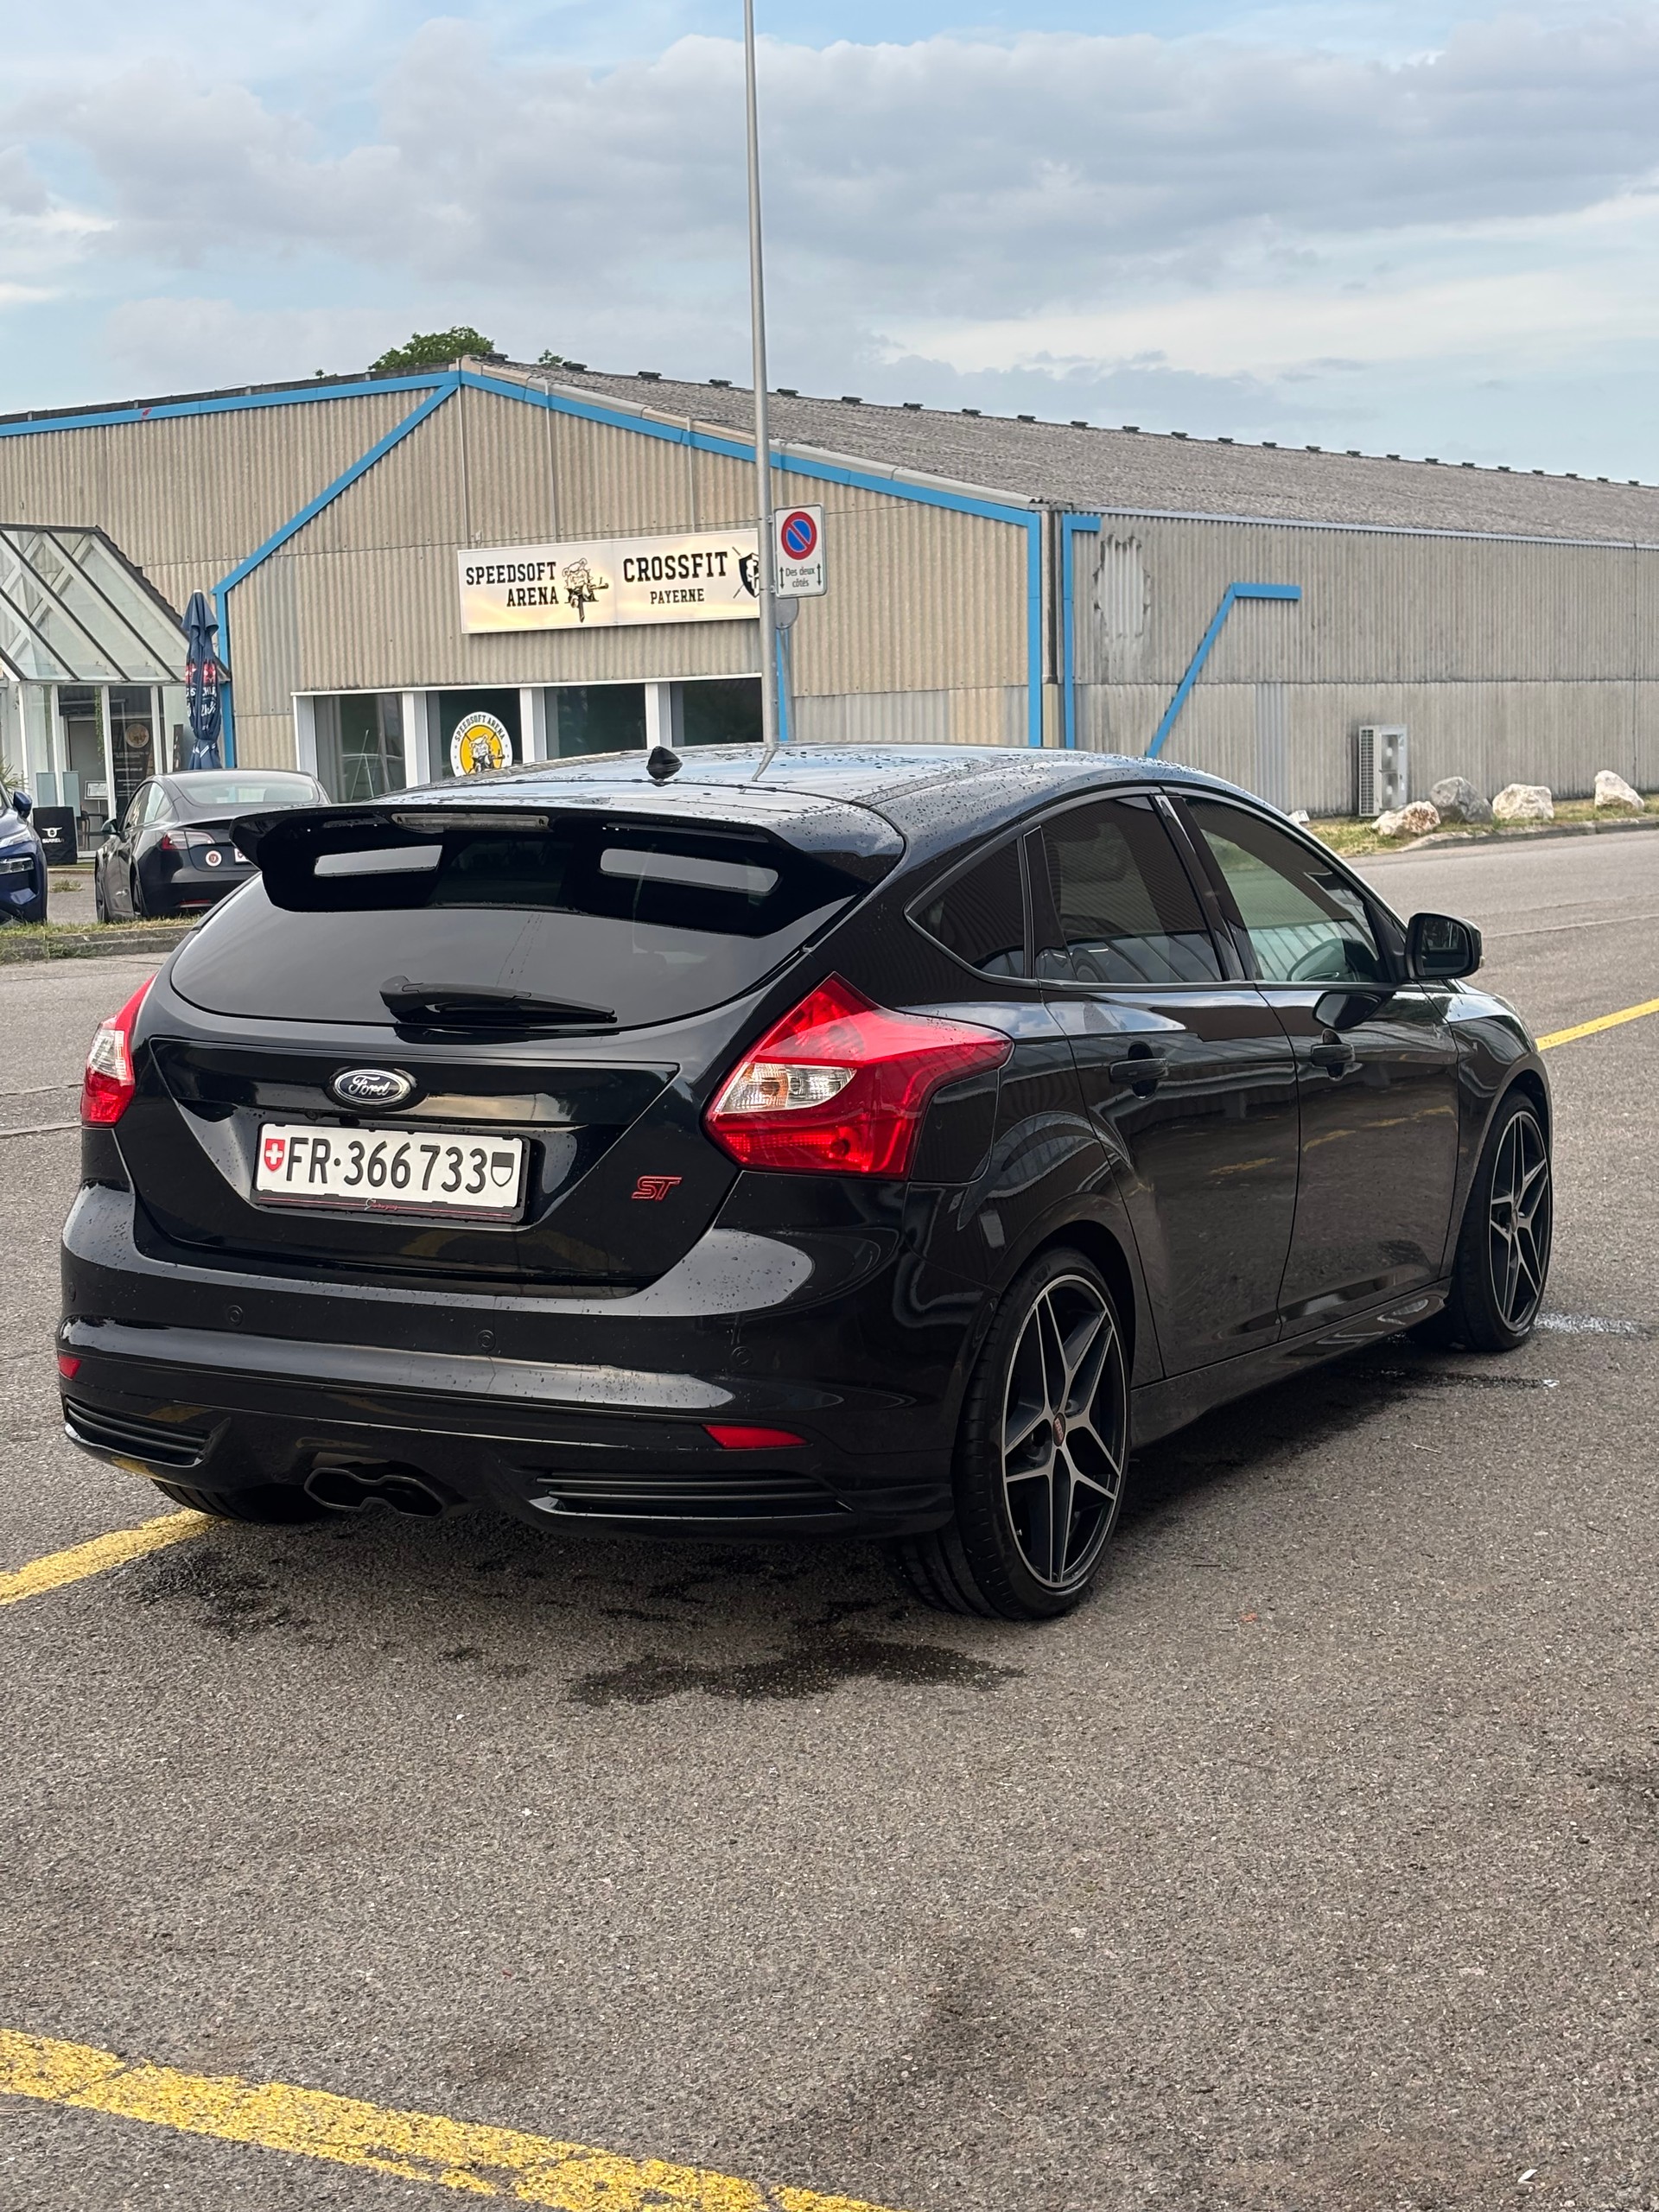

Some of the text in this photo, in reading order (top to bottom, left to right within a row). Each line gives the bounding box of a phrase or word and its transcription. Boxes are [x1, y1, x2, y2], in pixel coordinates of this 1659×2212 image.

[466, 562, 556, 585] SPEEDSOFT
[623, 551, 728, 582] CROSSFIT
[785, 567, 815, 577] Des deux
[506, 586, 559, 607] ARENA
[650, 588, 704, 604] PAYERNE
[454, 715, 505, 742] SPEEDSOFT ARENA
[348, 1075, 391, 1096] Ford
[632, 1175, 683, 1201] ST
